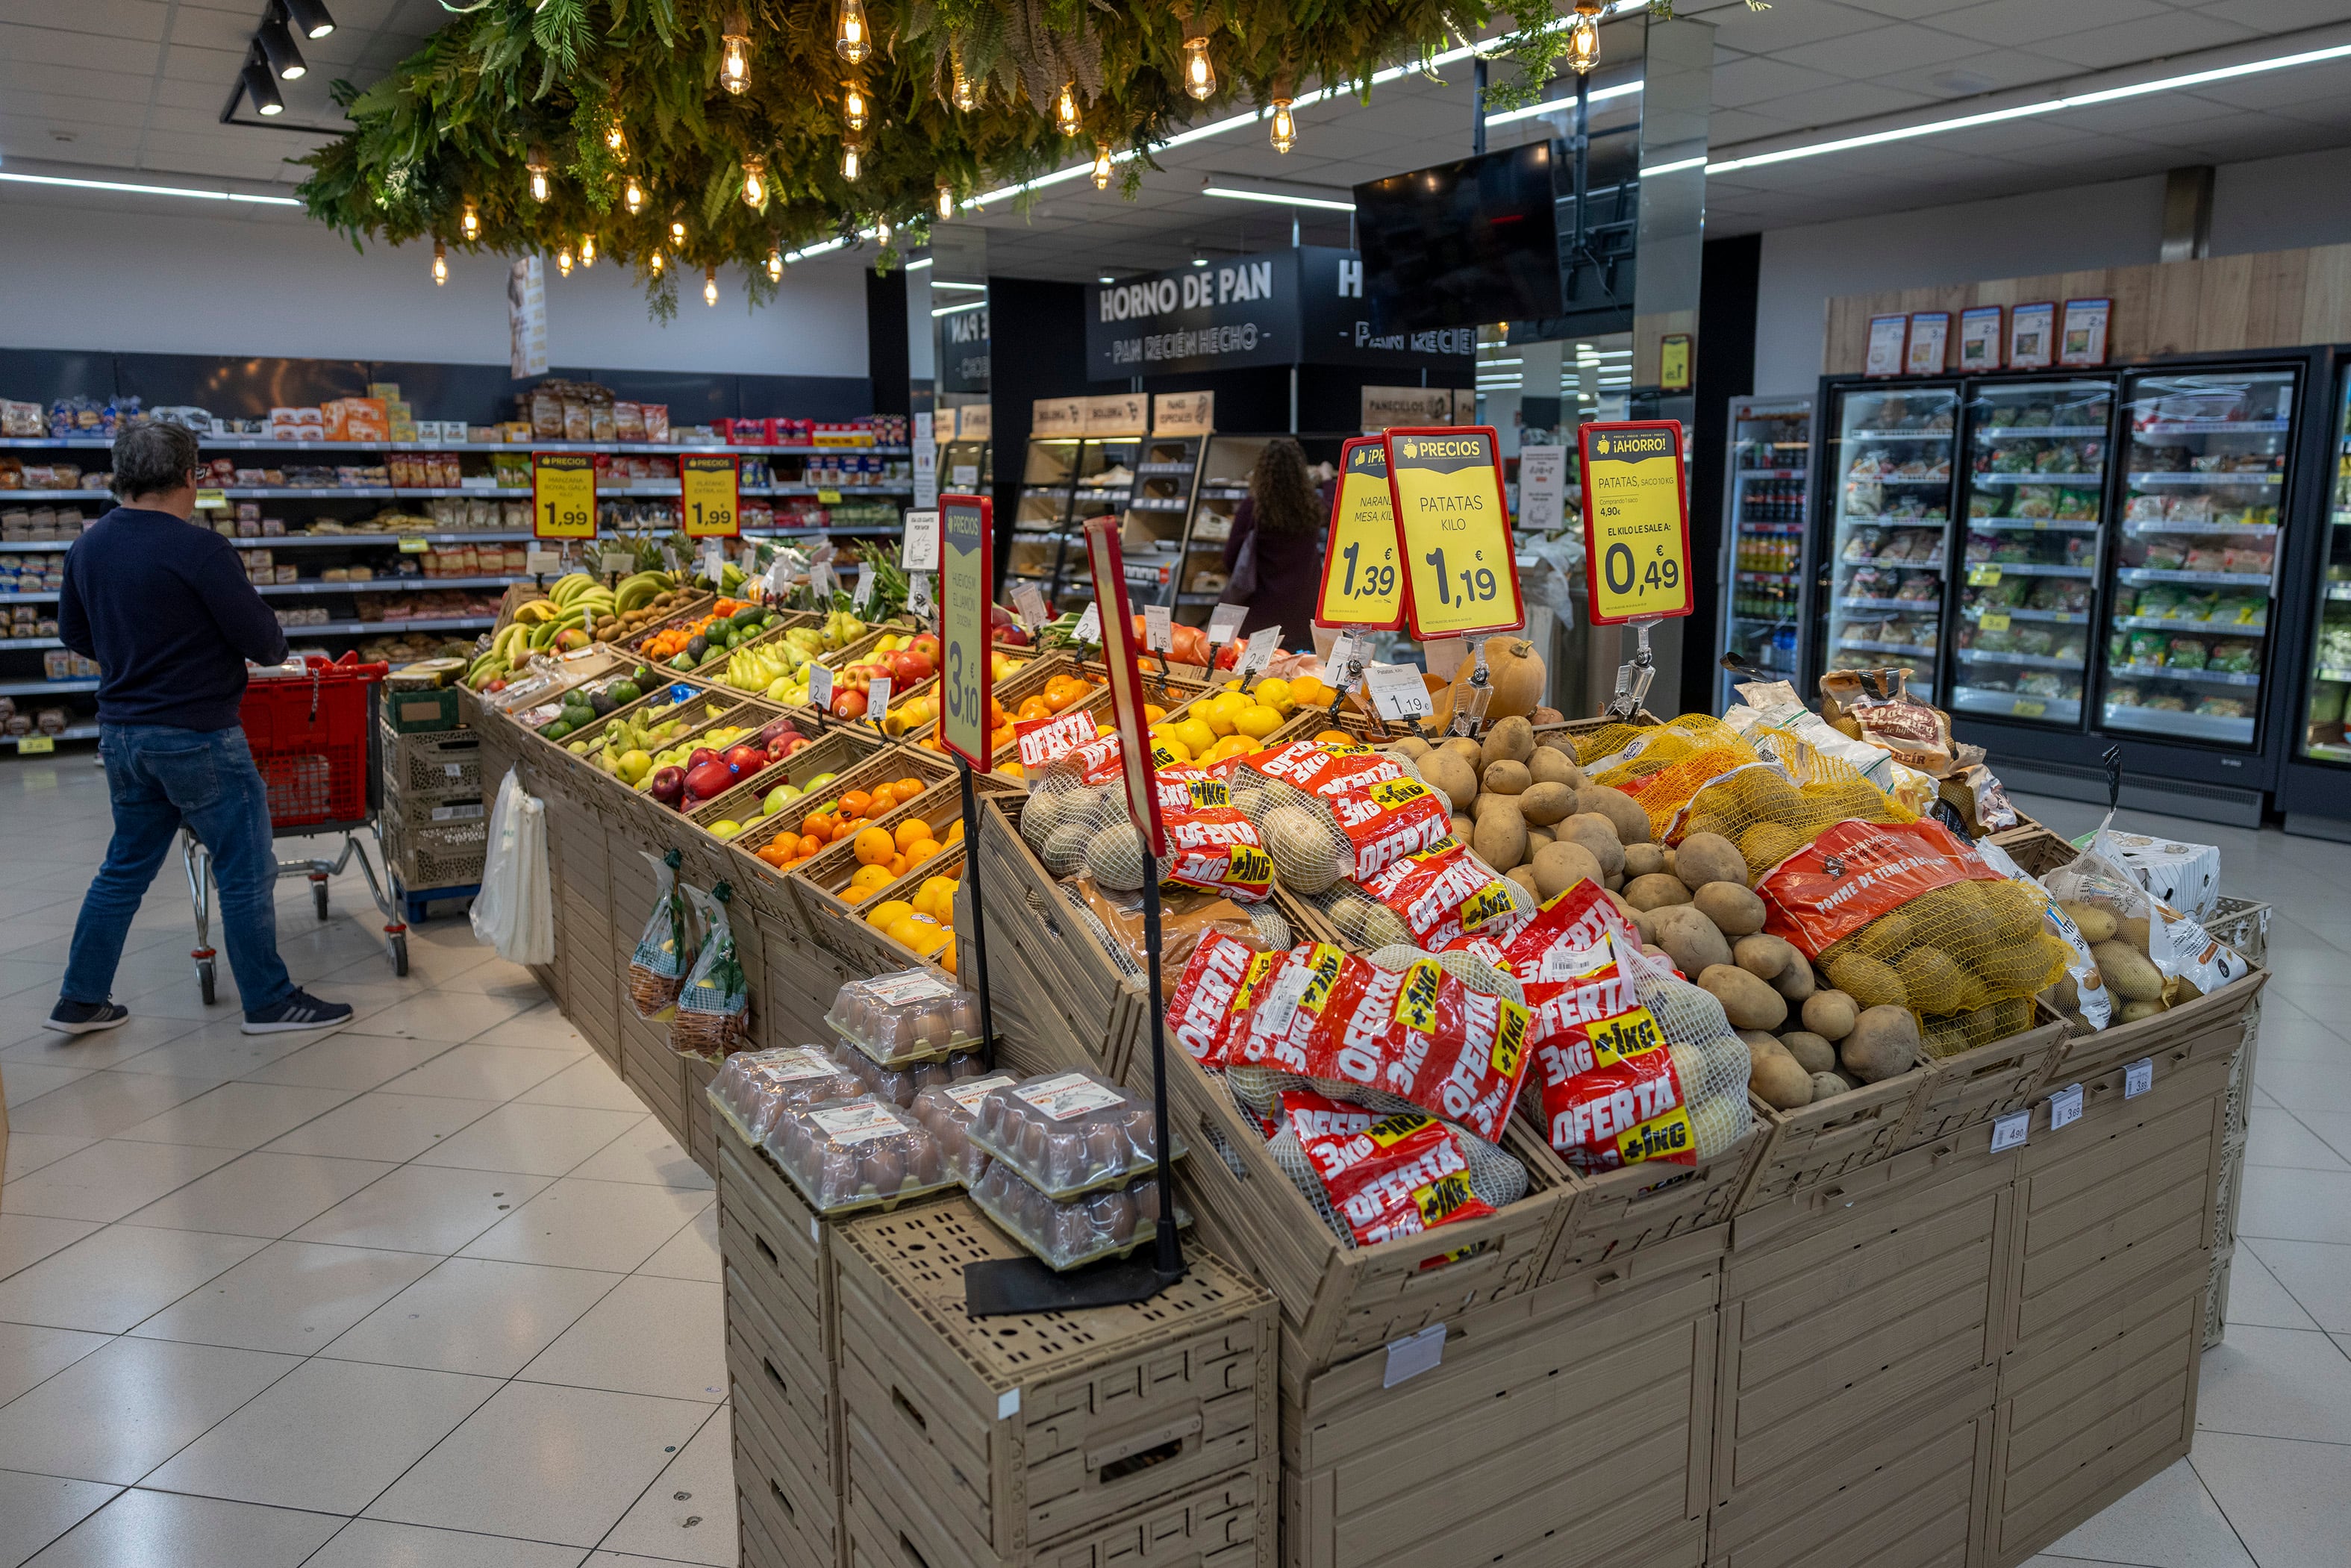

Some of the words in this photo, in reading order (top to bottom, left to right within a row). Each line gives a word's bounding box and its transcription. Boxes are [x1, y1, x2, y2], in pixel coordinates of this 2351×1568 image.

[1099, 278, 1178, 322] HORNO
[1183, 272, 1214, 310] DE
[1219, 261, 1272, 304] PAN
[1113, 338, 1143, 364] PAN
[1199, 322, 1258, 354] HECHO
[1370, 400, 1424, 412] PANECILLOS
[551, 457, 587, 466] PRECIOS
[697, 459, 730, 467] PRECIOS
[1420, 441, 1480, 457] PRECIOS
[1613, 437, 1667, 453] ¡AHORRO!
[1360, 496, 1392, 507] NARAN
[1598, 475, 1640, 489] PATATAS,
[1640, 478, 1658, 487] SACO
[1666, 476, 1674, 484] KG
[1599, 498, 1625, 506] Comprando
[544, 501, 587, 527] 1,99
[692, 502, 731, 527] 1,99
[1381, 510, 1393, 521] KIL
[1420, 495, 1484, 512] PATATAS
[1441, 518, 1466, 531] KILO
[953, 515, 978, 536] PRECIOS
[1608, 528, 1617, 536] EL
[1617, 526, 1633, 535] KILO
[1635, 525, 1643, 534] LE
[1644, 523, 1662, 533] SALE
[1664, 522, 1671, 531] A:
[1343, 542, 1395, 600] 1,39
[1384, 548, 1393, 560] €
[1426, 547, 1497, 609] 1,19
[1475, 550, 1484, 561] €
[1605, 543, 1679, 597] 0,49
[1656, 545, 1664, 556] €
[949, 640, 978, 728] 3,10
[1020, 710, 1096, 766] OFERTA
[1287, 752, 1330, 784] 3KG
[1337, 796, 1382, 828] 3KG
[1377, 781, 1426, 805] +1KG
[1175, 821, 1259, 849] OFERTA
[1358, 813, 1447, 881] OFERTA
[1176, 853, 1229, 881] 3KG
[1231, 847, 1273, 882] +1KG
[1370, 858, 1418, 900] 3KG
[1407, 857, 1491, 936] OFERTA
[1464, 888, 1514, 928] +1KG
[1815, 881, 1858, 915] POMME
[1858, 872, 1876, 889] DE
[1874, 859, 1909, 879] TERRE
[1177, 937, 1251, 1060] OFERTA
[1274, 1009, 1316, 1072] 3KG
[1304, 955, 1344, 1005] +1KG
[1338, 969, 1404, 1083] OFERTA
[1387, 1033, 1431, 1096] 3KG
[1411, 964, 1440, 1027] +1KG
[1443, 989, 1494, 1119] OFERTA
[1468, 1084, 1510, 1135] 3KG
[1501, 1011, 1526, 1073] +1KG
[1538, 1043, 1595, 1087] 3KG
[1595, 1019, 1658, 1055] +1KG
[1552, 1075, 1677, 1151] OFERTA
[1311, 1134, 1374, 1181] 3KG
[1624, 1121, 1687, 1159] +1KG
[1346, 1137, 1467, 1228] OFERTA
[1423, 1177, 1471, 1225] +1KG
